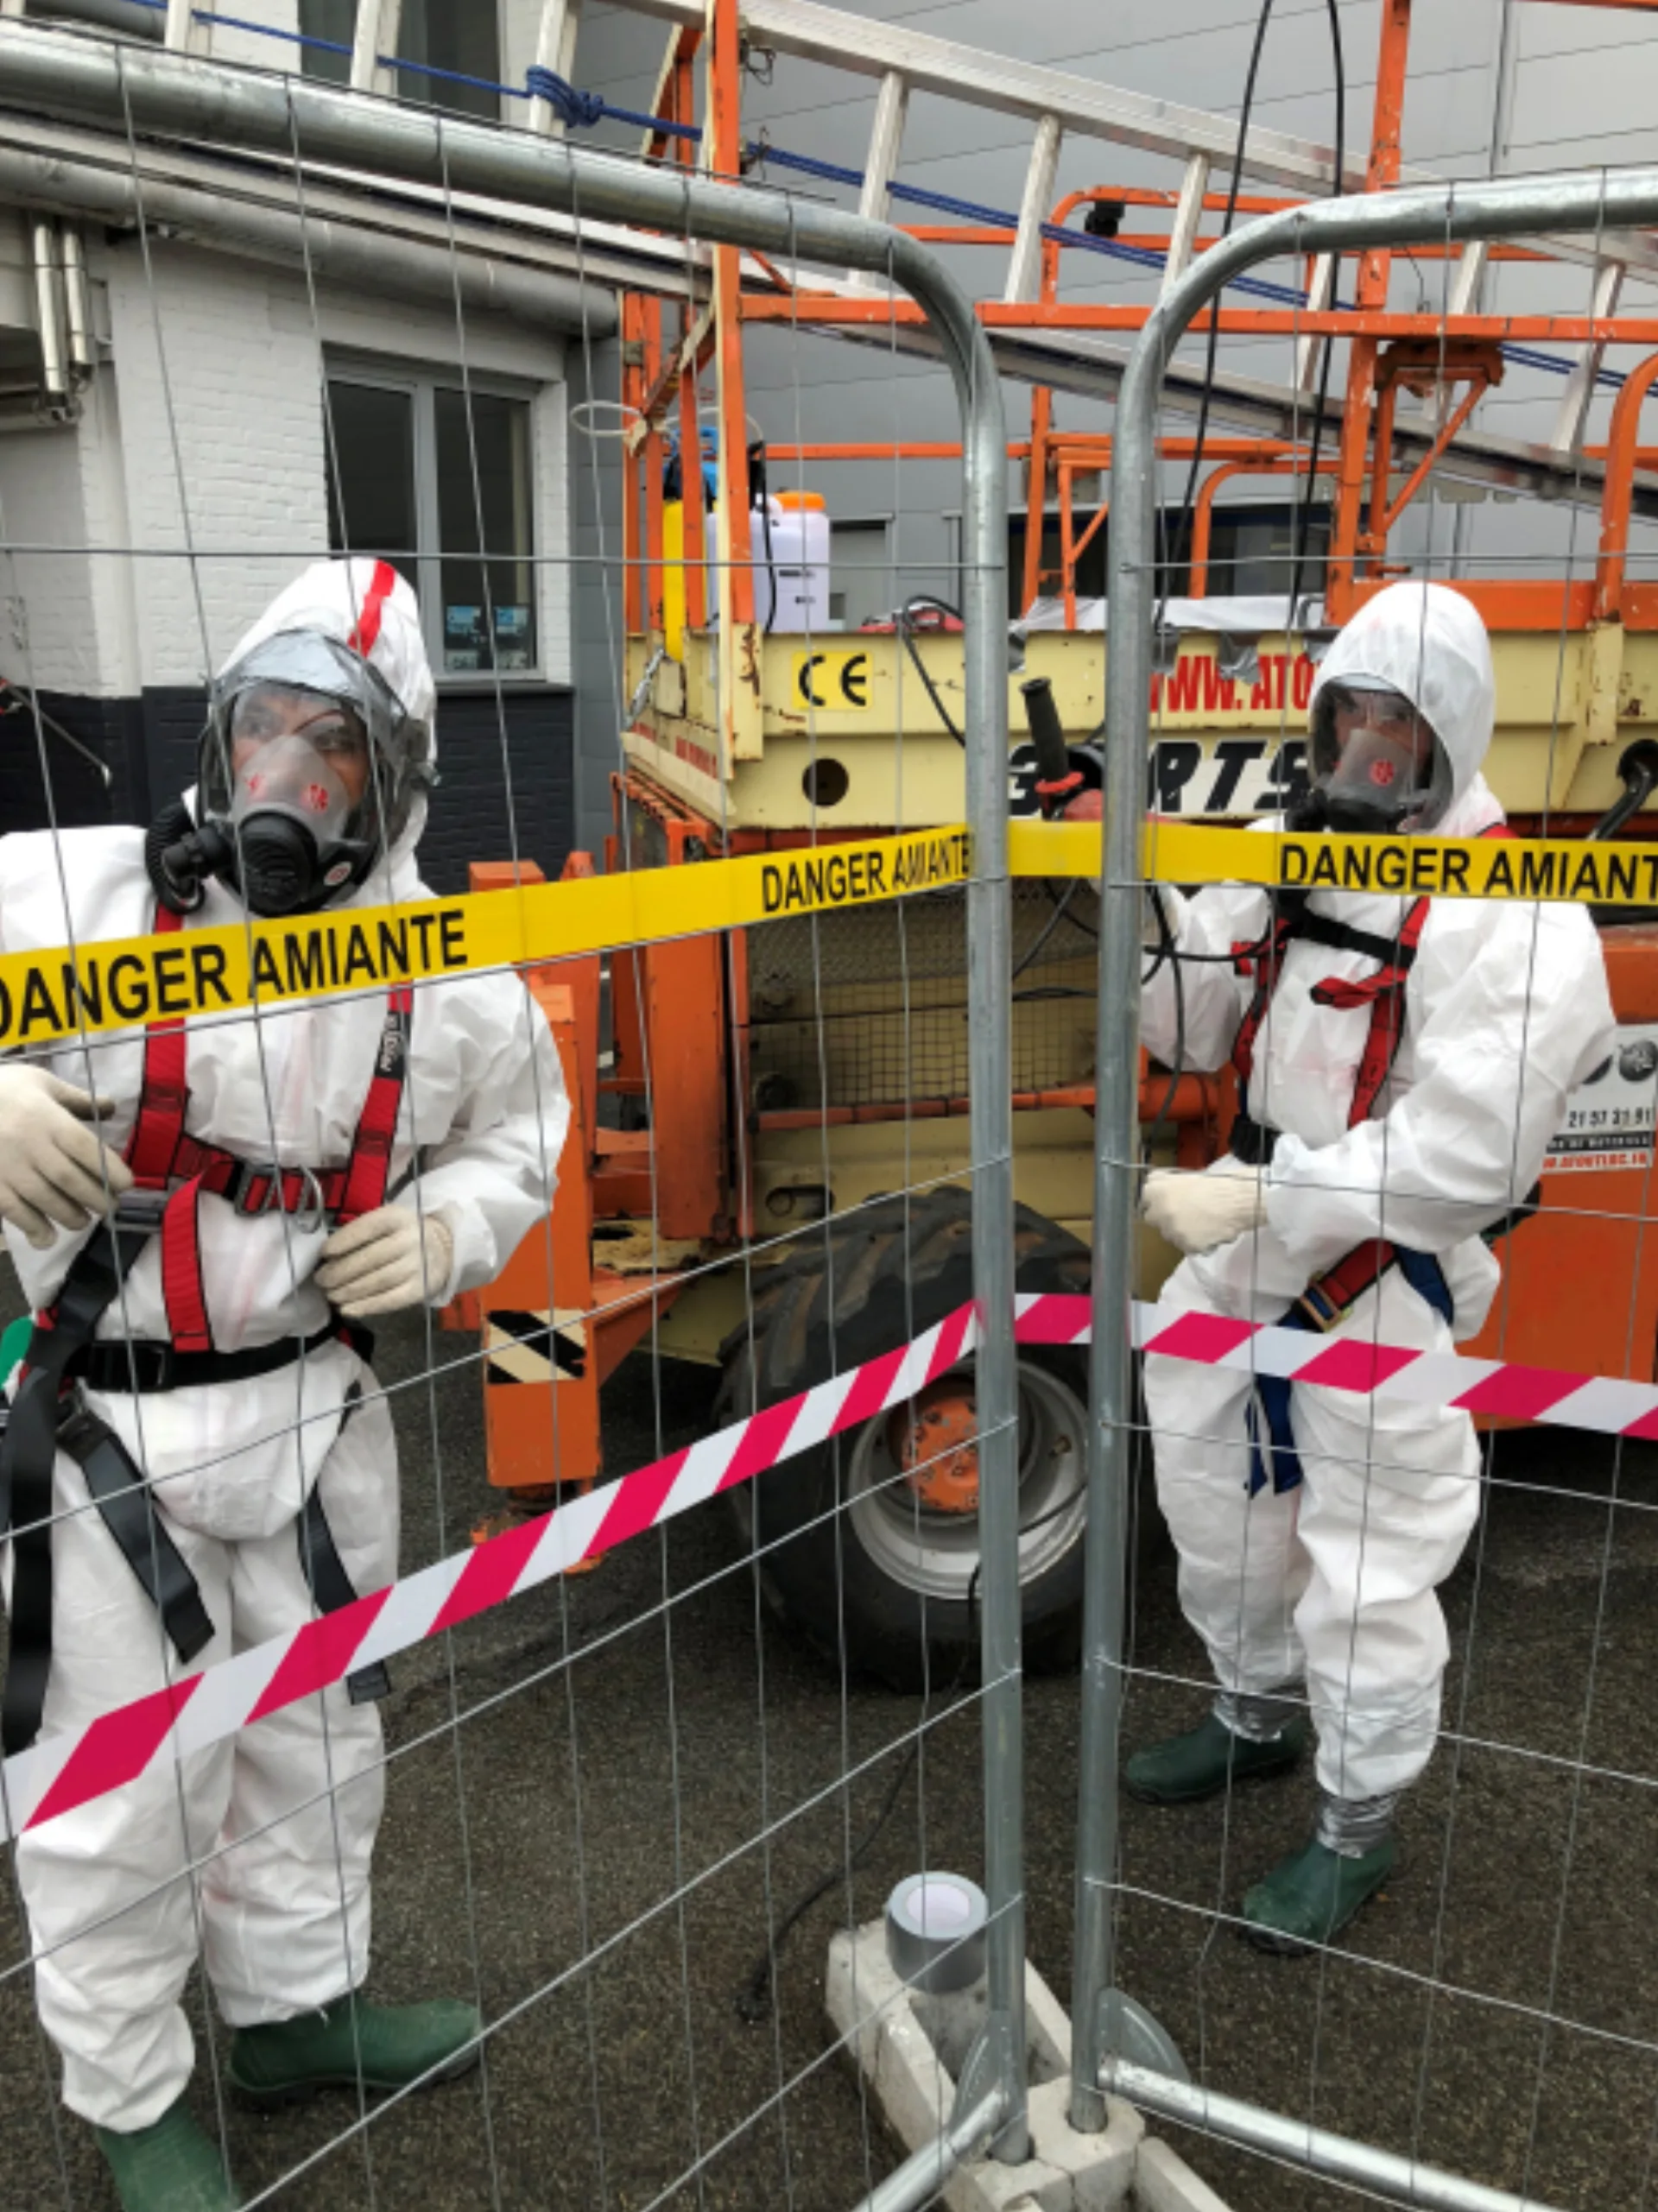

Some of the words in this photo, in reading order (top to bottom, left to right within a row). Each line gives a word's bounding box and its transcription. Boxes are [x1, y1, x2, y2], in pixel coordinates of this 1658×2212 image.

[799, 654, 867, 706] CE
[763, 850, 887, 913] DANGER
[1281, 844, 1471, 894] DANGER
[248, 909, 468, 999] AMIANTE
